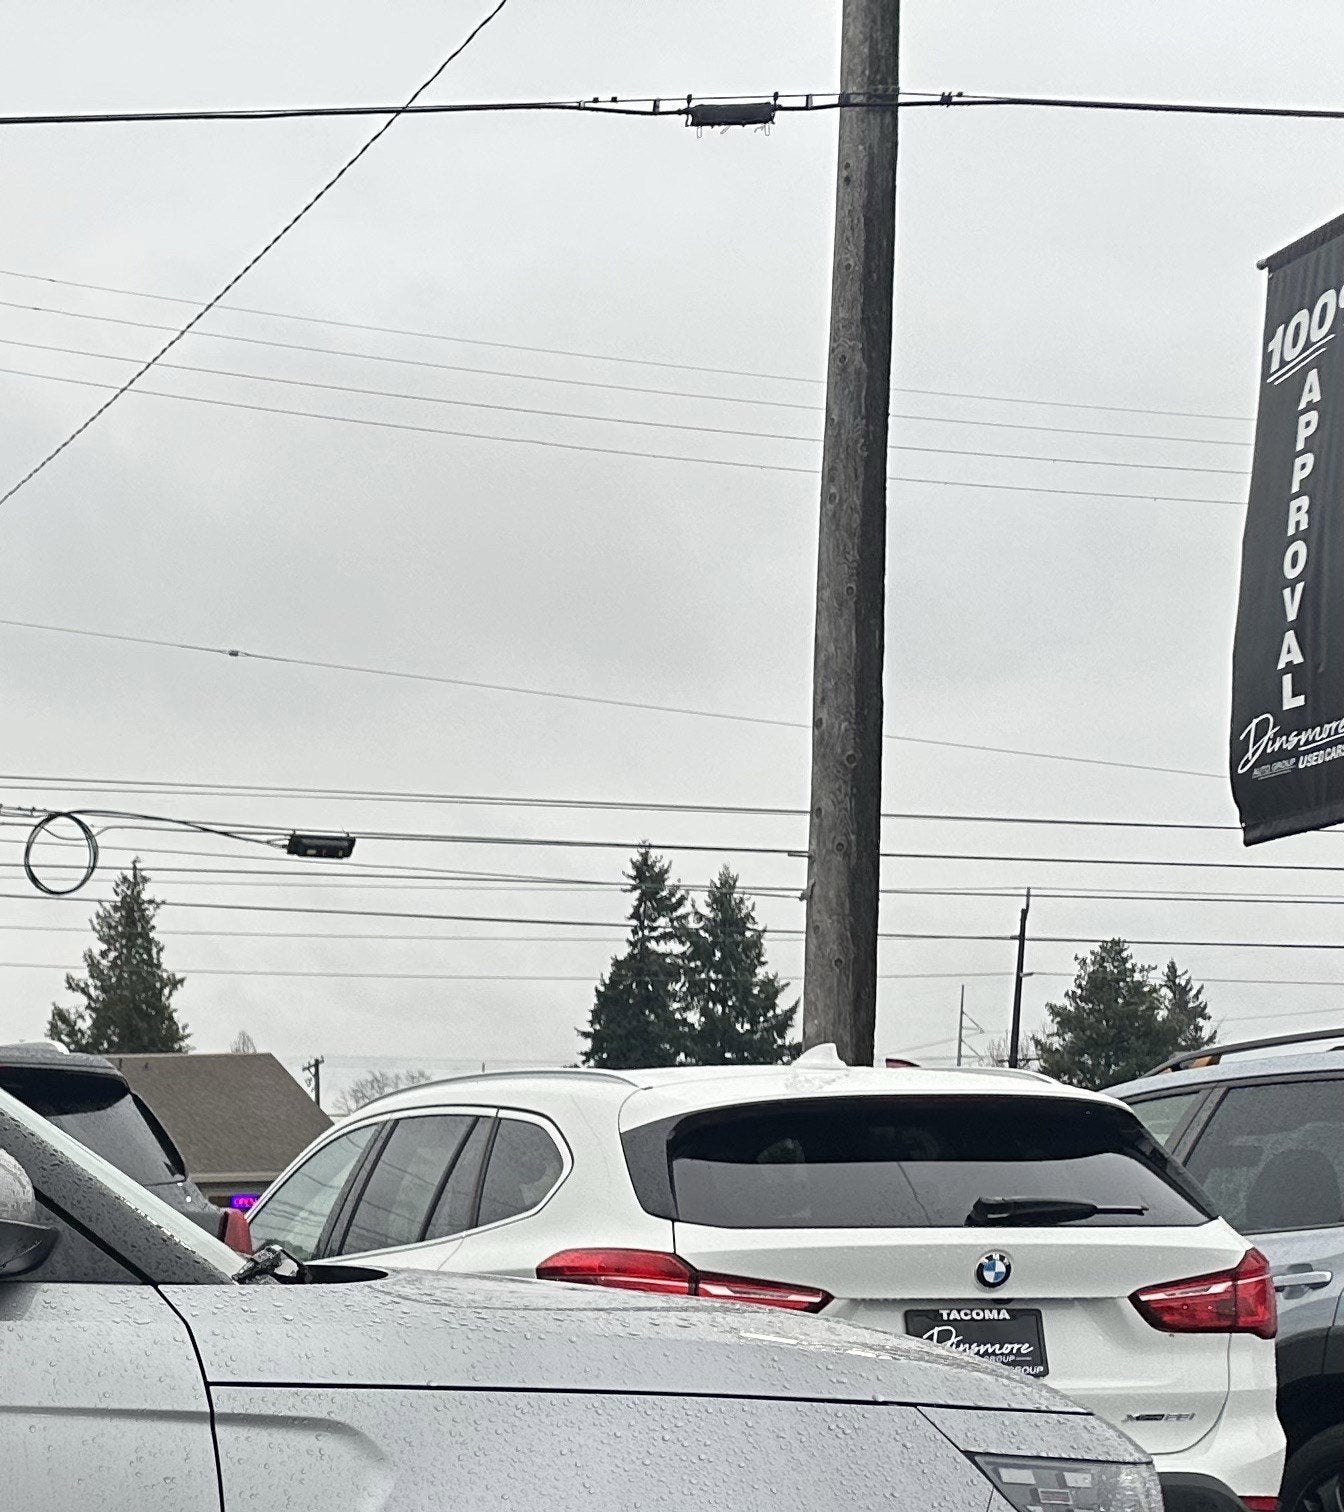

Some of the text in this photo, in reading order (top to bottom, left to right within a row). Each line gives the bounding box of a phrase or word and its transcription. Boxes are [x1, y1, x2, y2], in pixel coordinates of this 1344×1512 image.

[1268, 284, 1344, 374] 100
[1277, 368, 1321, 711] APPROVAL
[939, 1309, 1010, 1320] TACOMA
